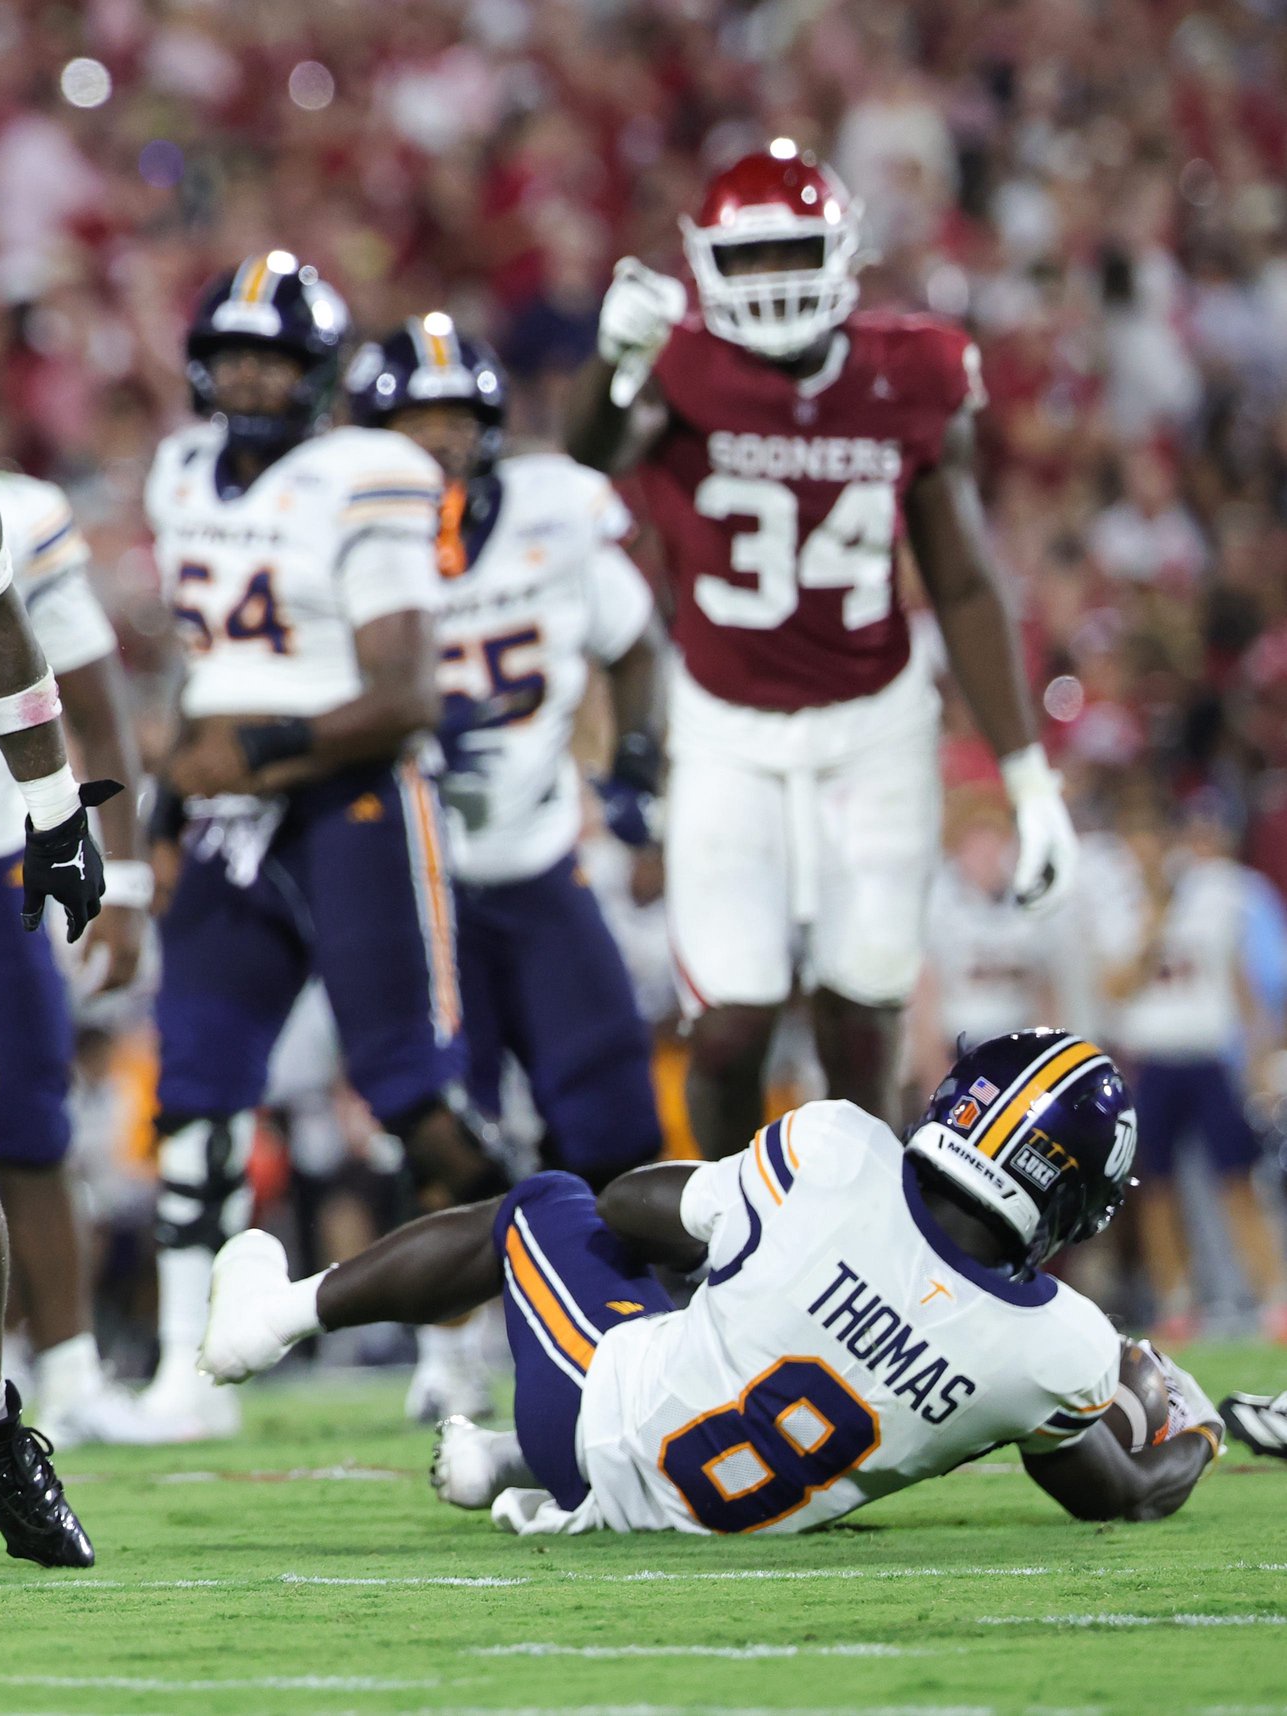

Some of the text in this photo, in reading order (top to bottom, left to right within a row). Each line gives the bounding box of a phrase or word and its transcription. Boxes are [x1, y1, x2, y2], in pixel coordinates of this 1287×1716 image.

[708, 431, 902, 481] SOONERS
[694, 473, 896, 631] 34
[947, 1141, 1005, 1190] MINERS
[1014, 1147, 1056, 1187] LUKE
[806, 1260, 976, 1425] THOMAS
[657, 1354, 882, 1535] 8
